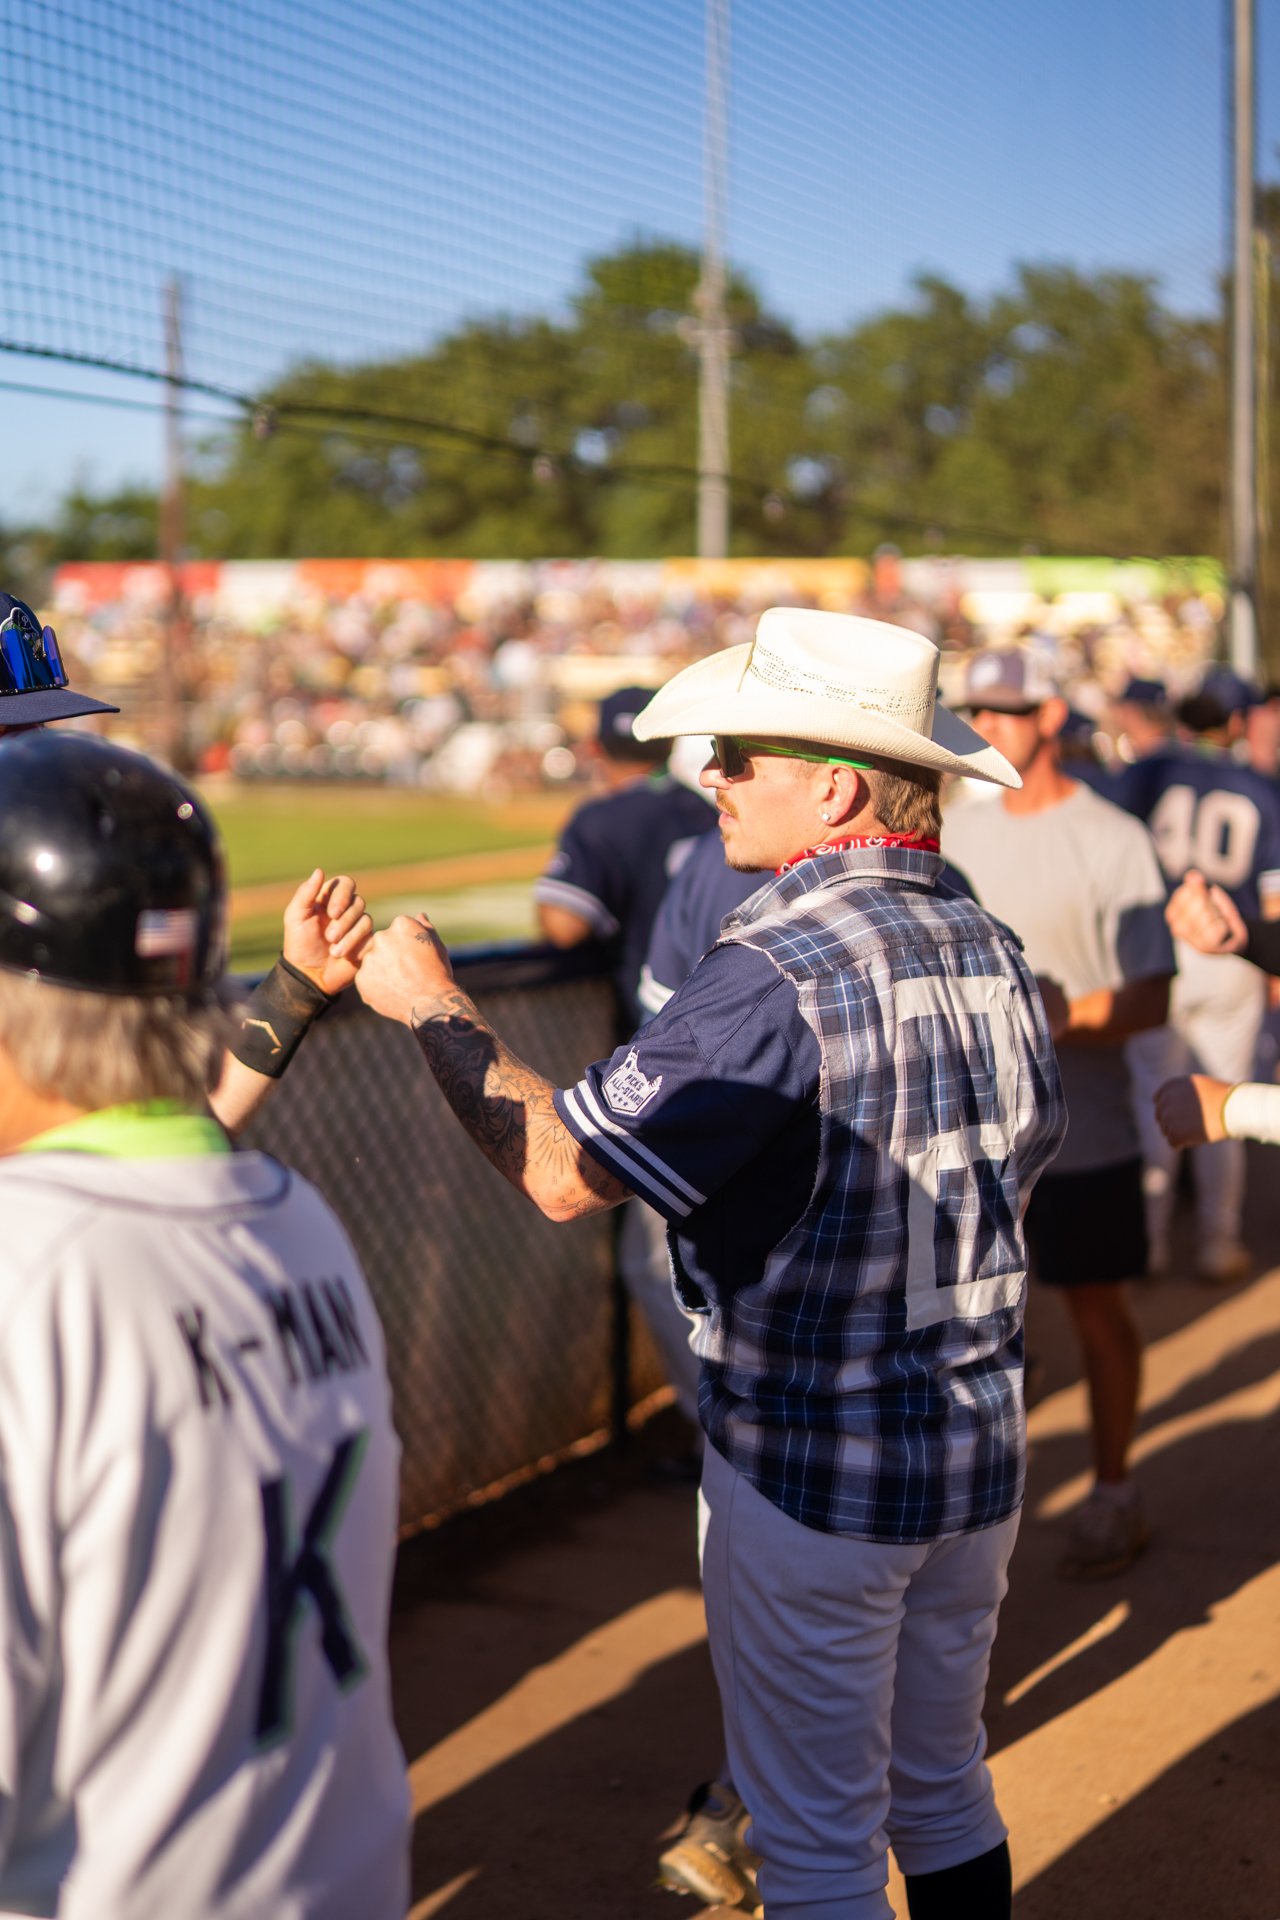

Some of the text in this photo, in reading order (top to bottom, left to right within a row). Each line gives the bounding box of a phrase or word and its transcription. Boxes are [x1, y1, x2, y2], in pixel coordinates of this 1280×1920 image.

[1151, 785, 1260, 886] 40
[610, 1077, 644, 1105] ALL-STARS
[894, 975, 1027, 1332] 2
[177, 1277, 369, 1412] K-MAN
[255, 1428, 369, 1748] K
